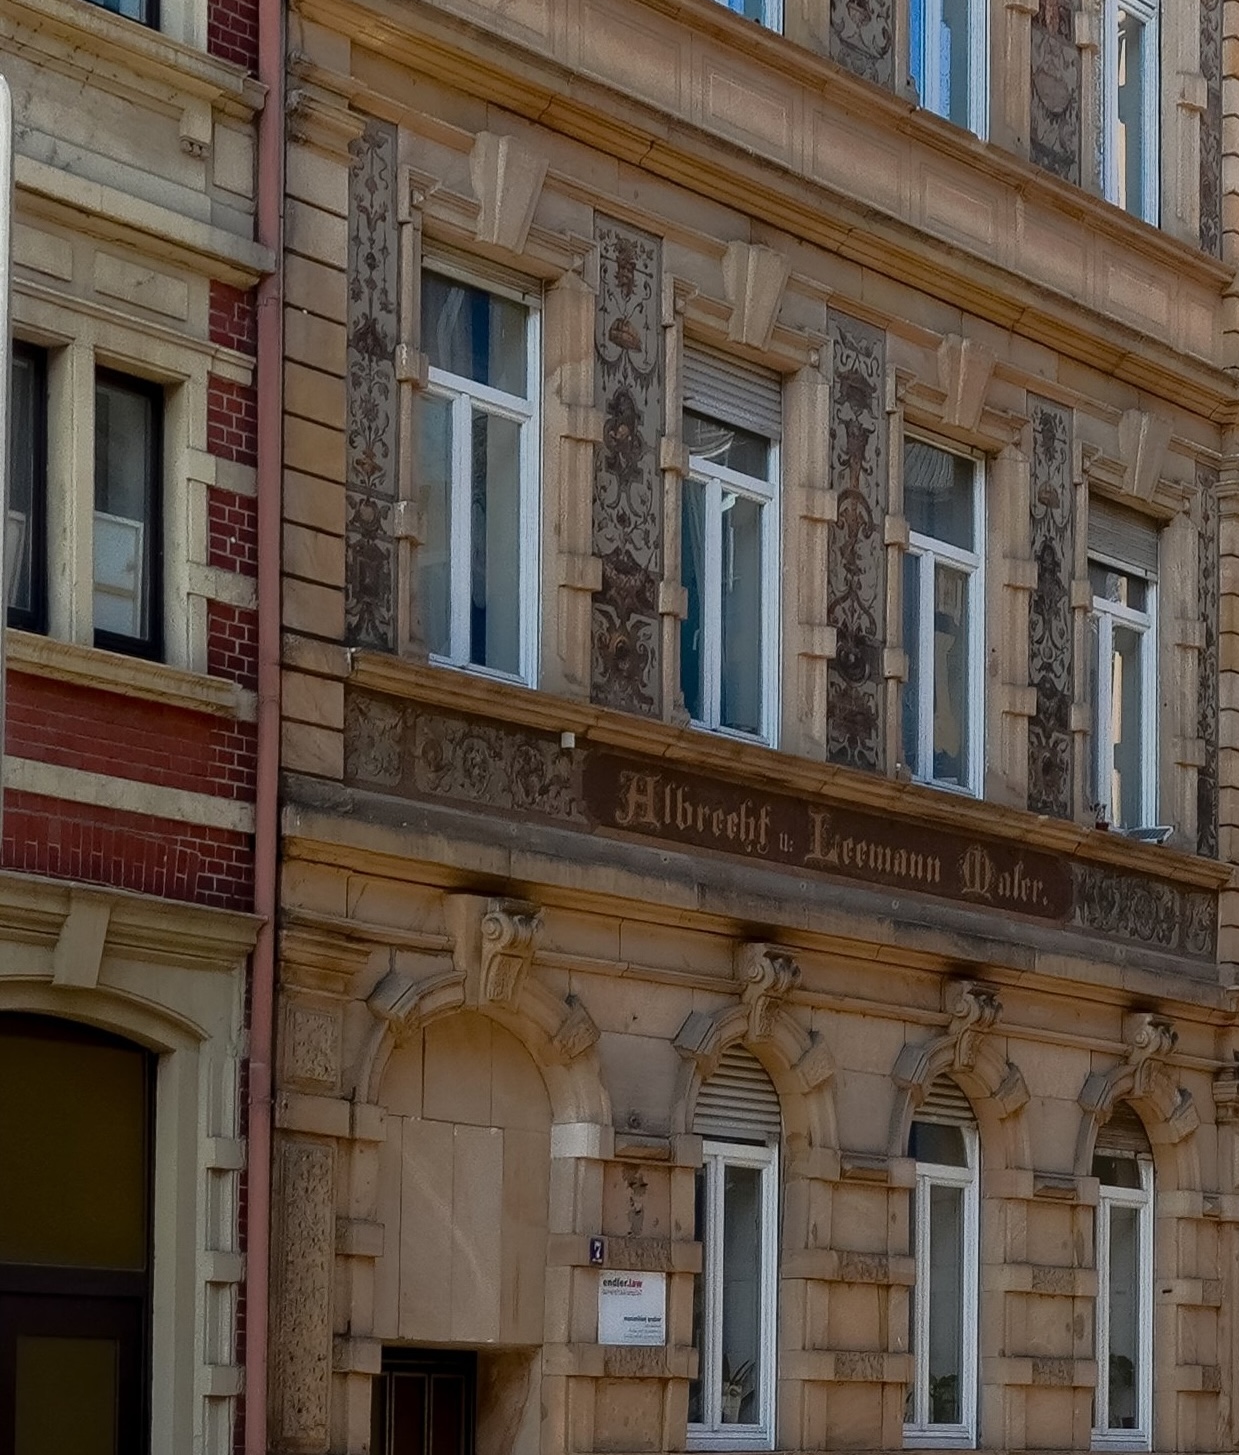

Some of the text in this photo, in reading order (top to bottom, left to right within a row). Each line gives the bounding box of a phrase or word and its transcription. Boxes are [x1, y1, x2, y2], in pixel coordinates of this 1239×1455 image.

[615, 770, 771, 854] Albrecht
[804, 805, 941, 883] Leemann
[592, 1241, 602, 1261] 7
